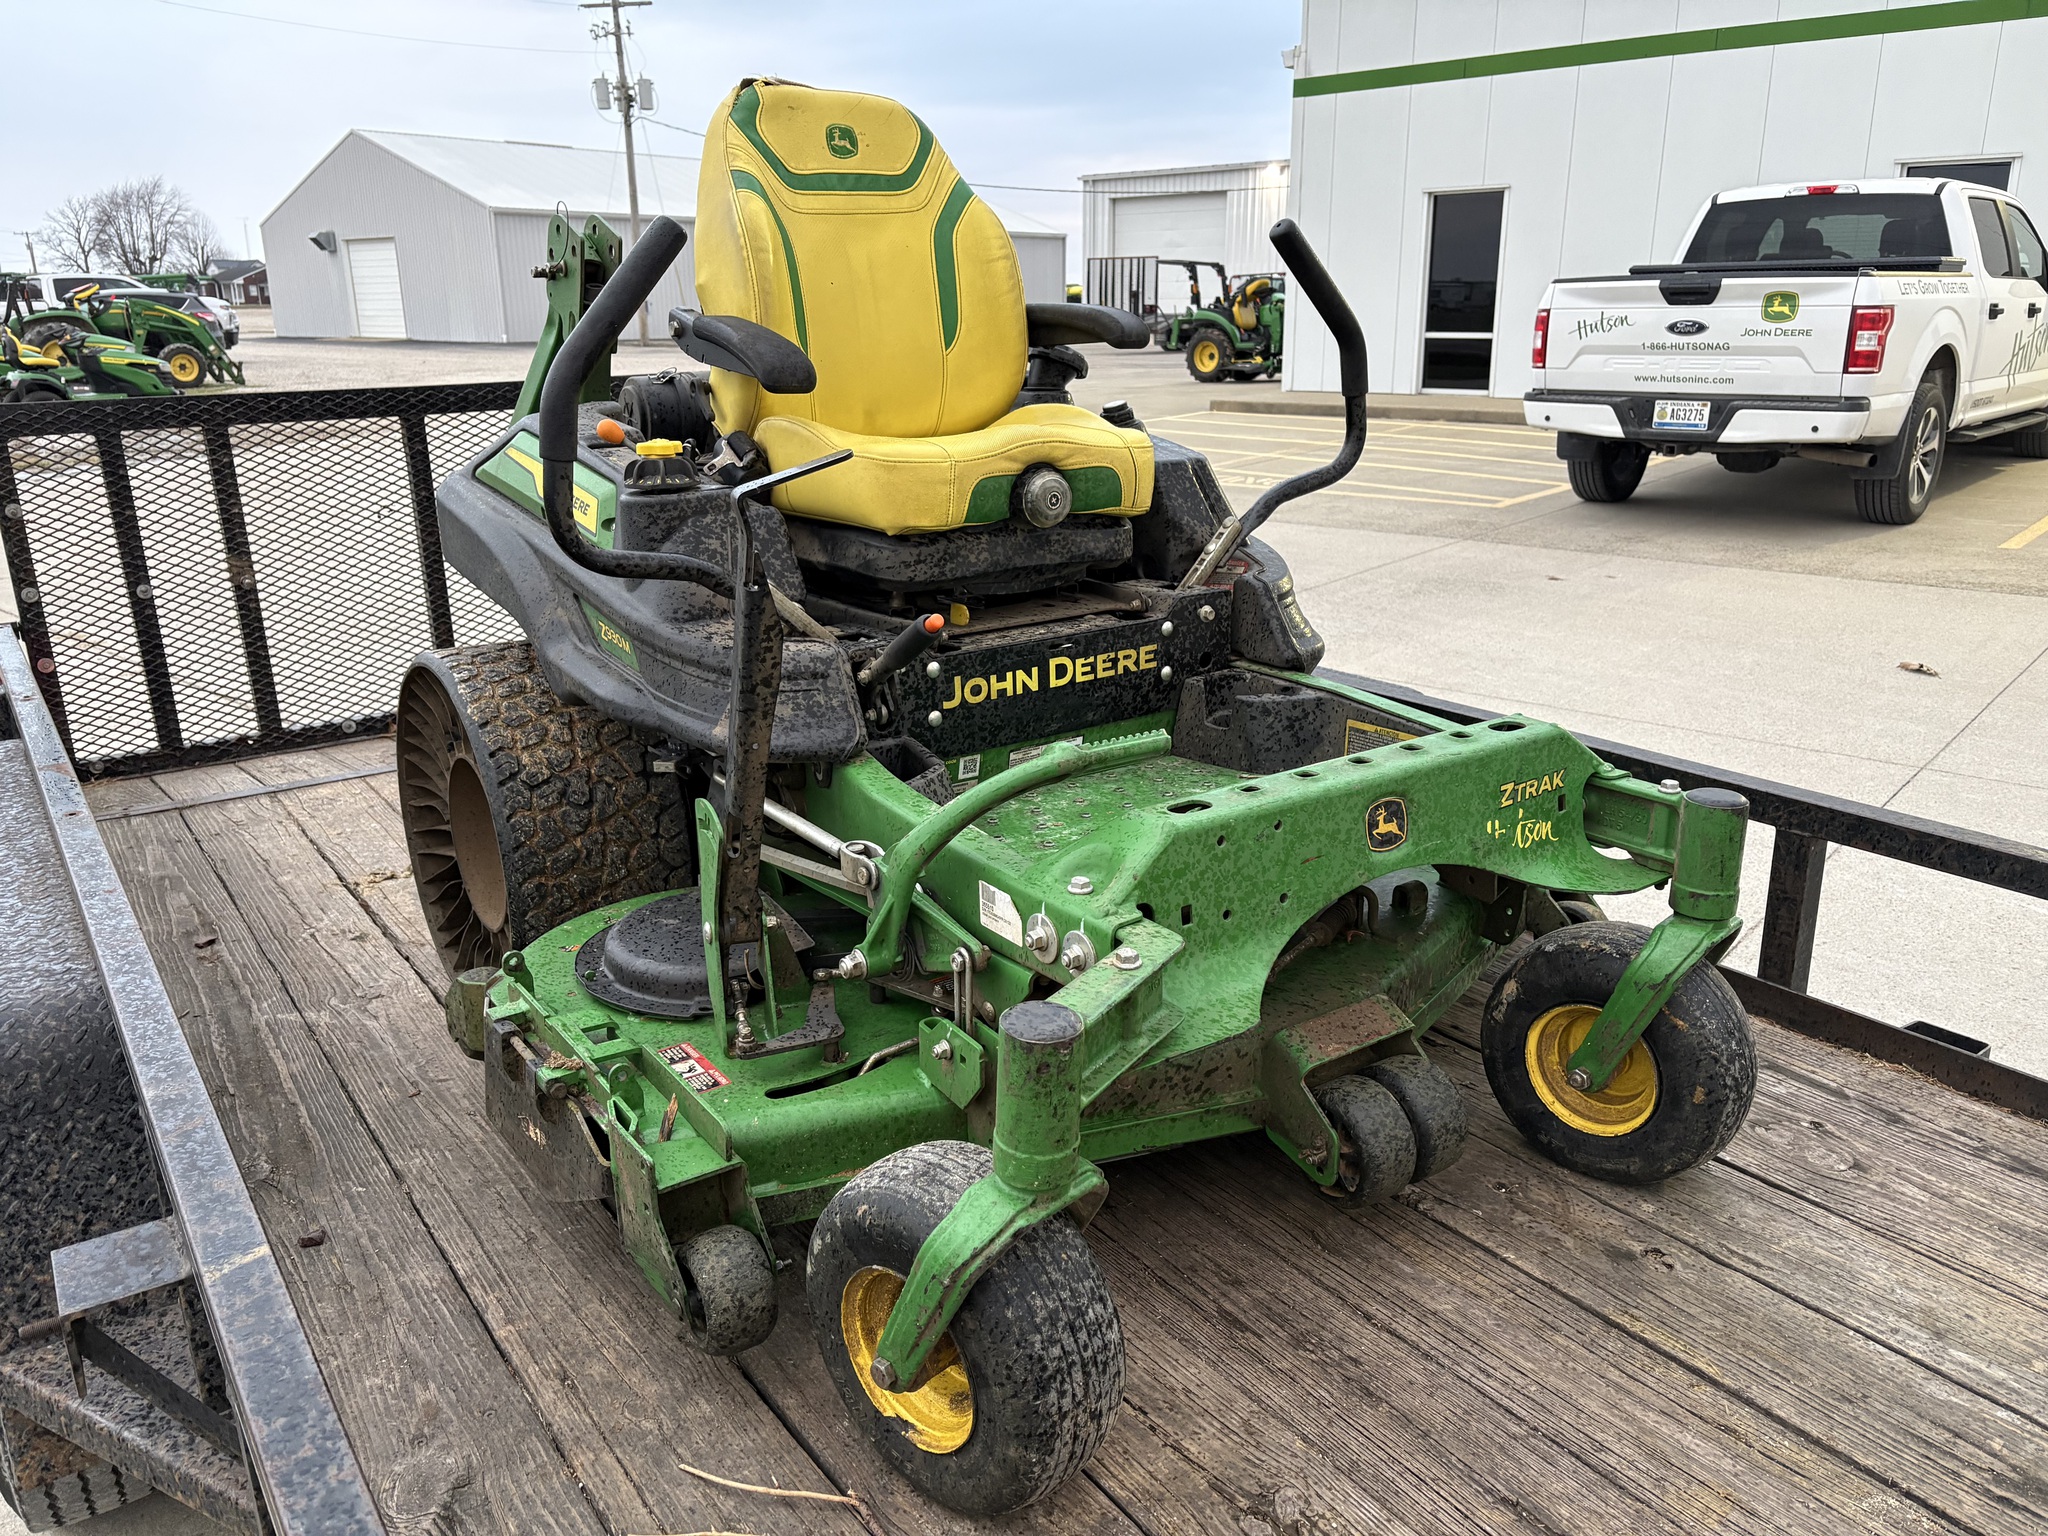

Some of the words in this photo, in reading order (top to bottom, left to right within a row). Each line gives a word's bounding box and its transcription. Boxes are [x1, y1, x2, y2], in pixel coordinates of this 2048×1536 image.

[1897, 280, 1918, 295] LET'S
[1917, 280, 1939, 295] GROW
[1938, 280, 1970, 294] TOGETHER
[1568, 311, 1636, 341] Hutson
[1740, 327, 1772, 338] JOHN
[1773, 327, 1813, 338] DEERE
[1641, 341, 1731, 352] 1-866-HUTSONAG
[1999, 314, 2048, 394] Hutso
[1633, 373, 1735, 386] www.hutsoninc.com
[1669, 408, 1704, 422] AG3275
[572, 495, 591, 518] ERE
[942, 665, 1039, 710] JOHN
[1048, 644, 1158, 689] DEERE
[1499, 768, 1567, 809] ZTRAK
